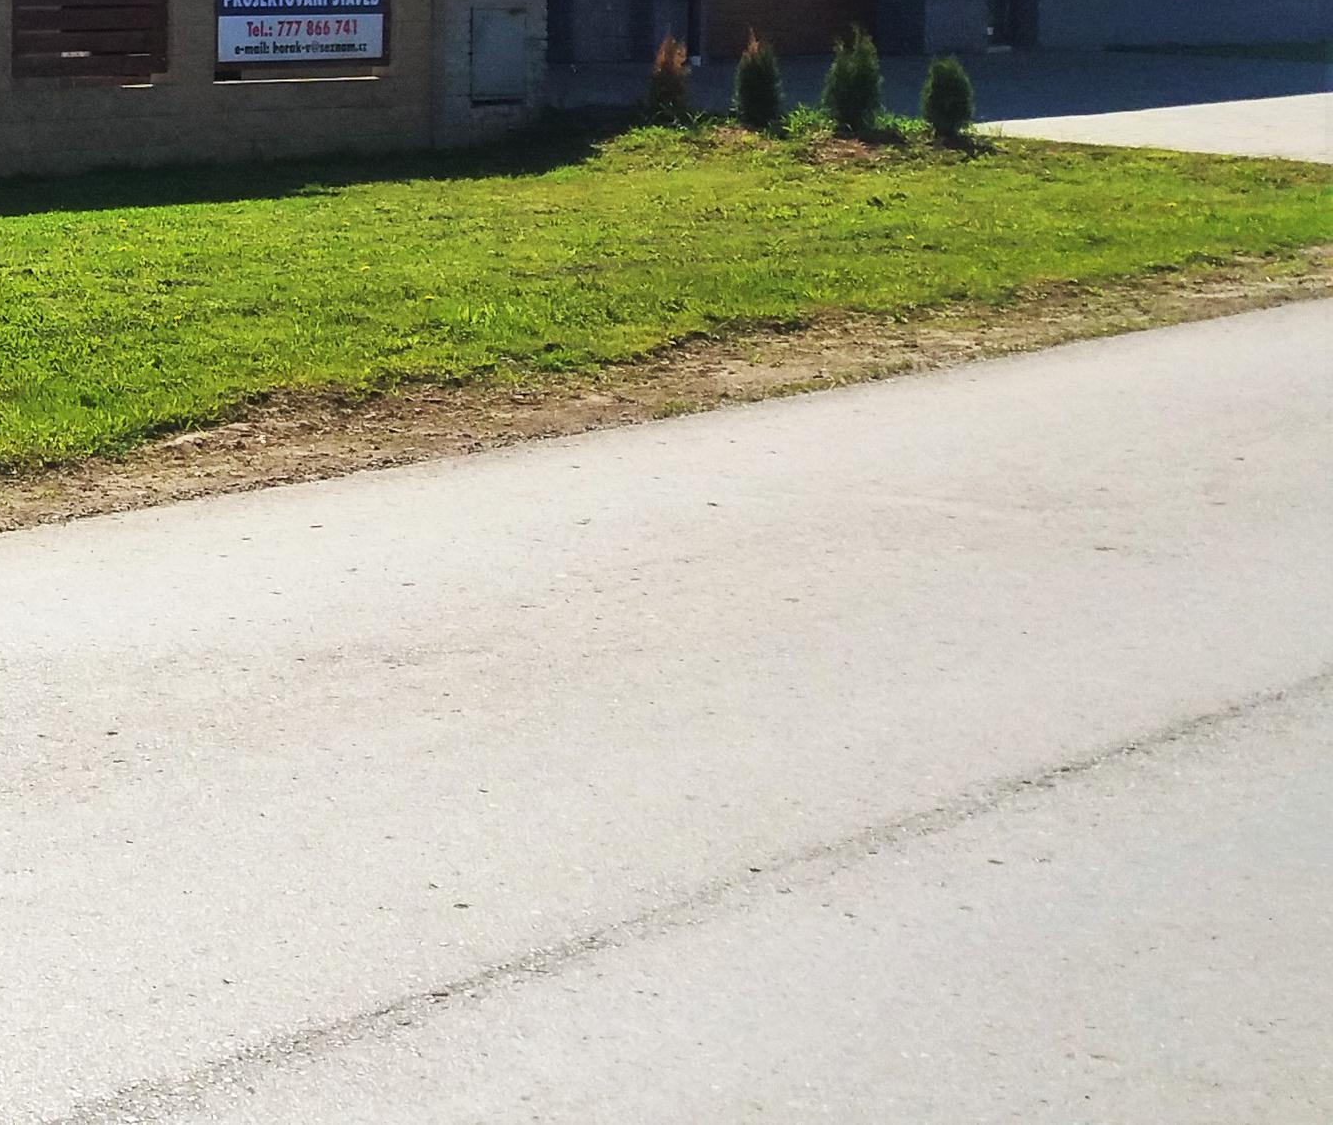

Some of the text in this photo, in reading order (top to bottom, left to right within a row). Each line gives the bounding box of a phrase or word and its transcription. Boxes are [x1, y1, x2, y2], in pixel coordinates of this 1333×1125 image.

[247, 20, 357, 37] Tel.: 777 866 741
